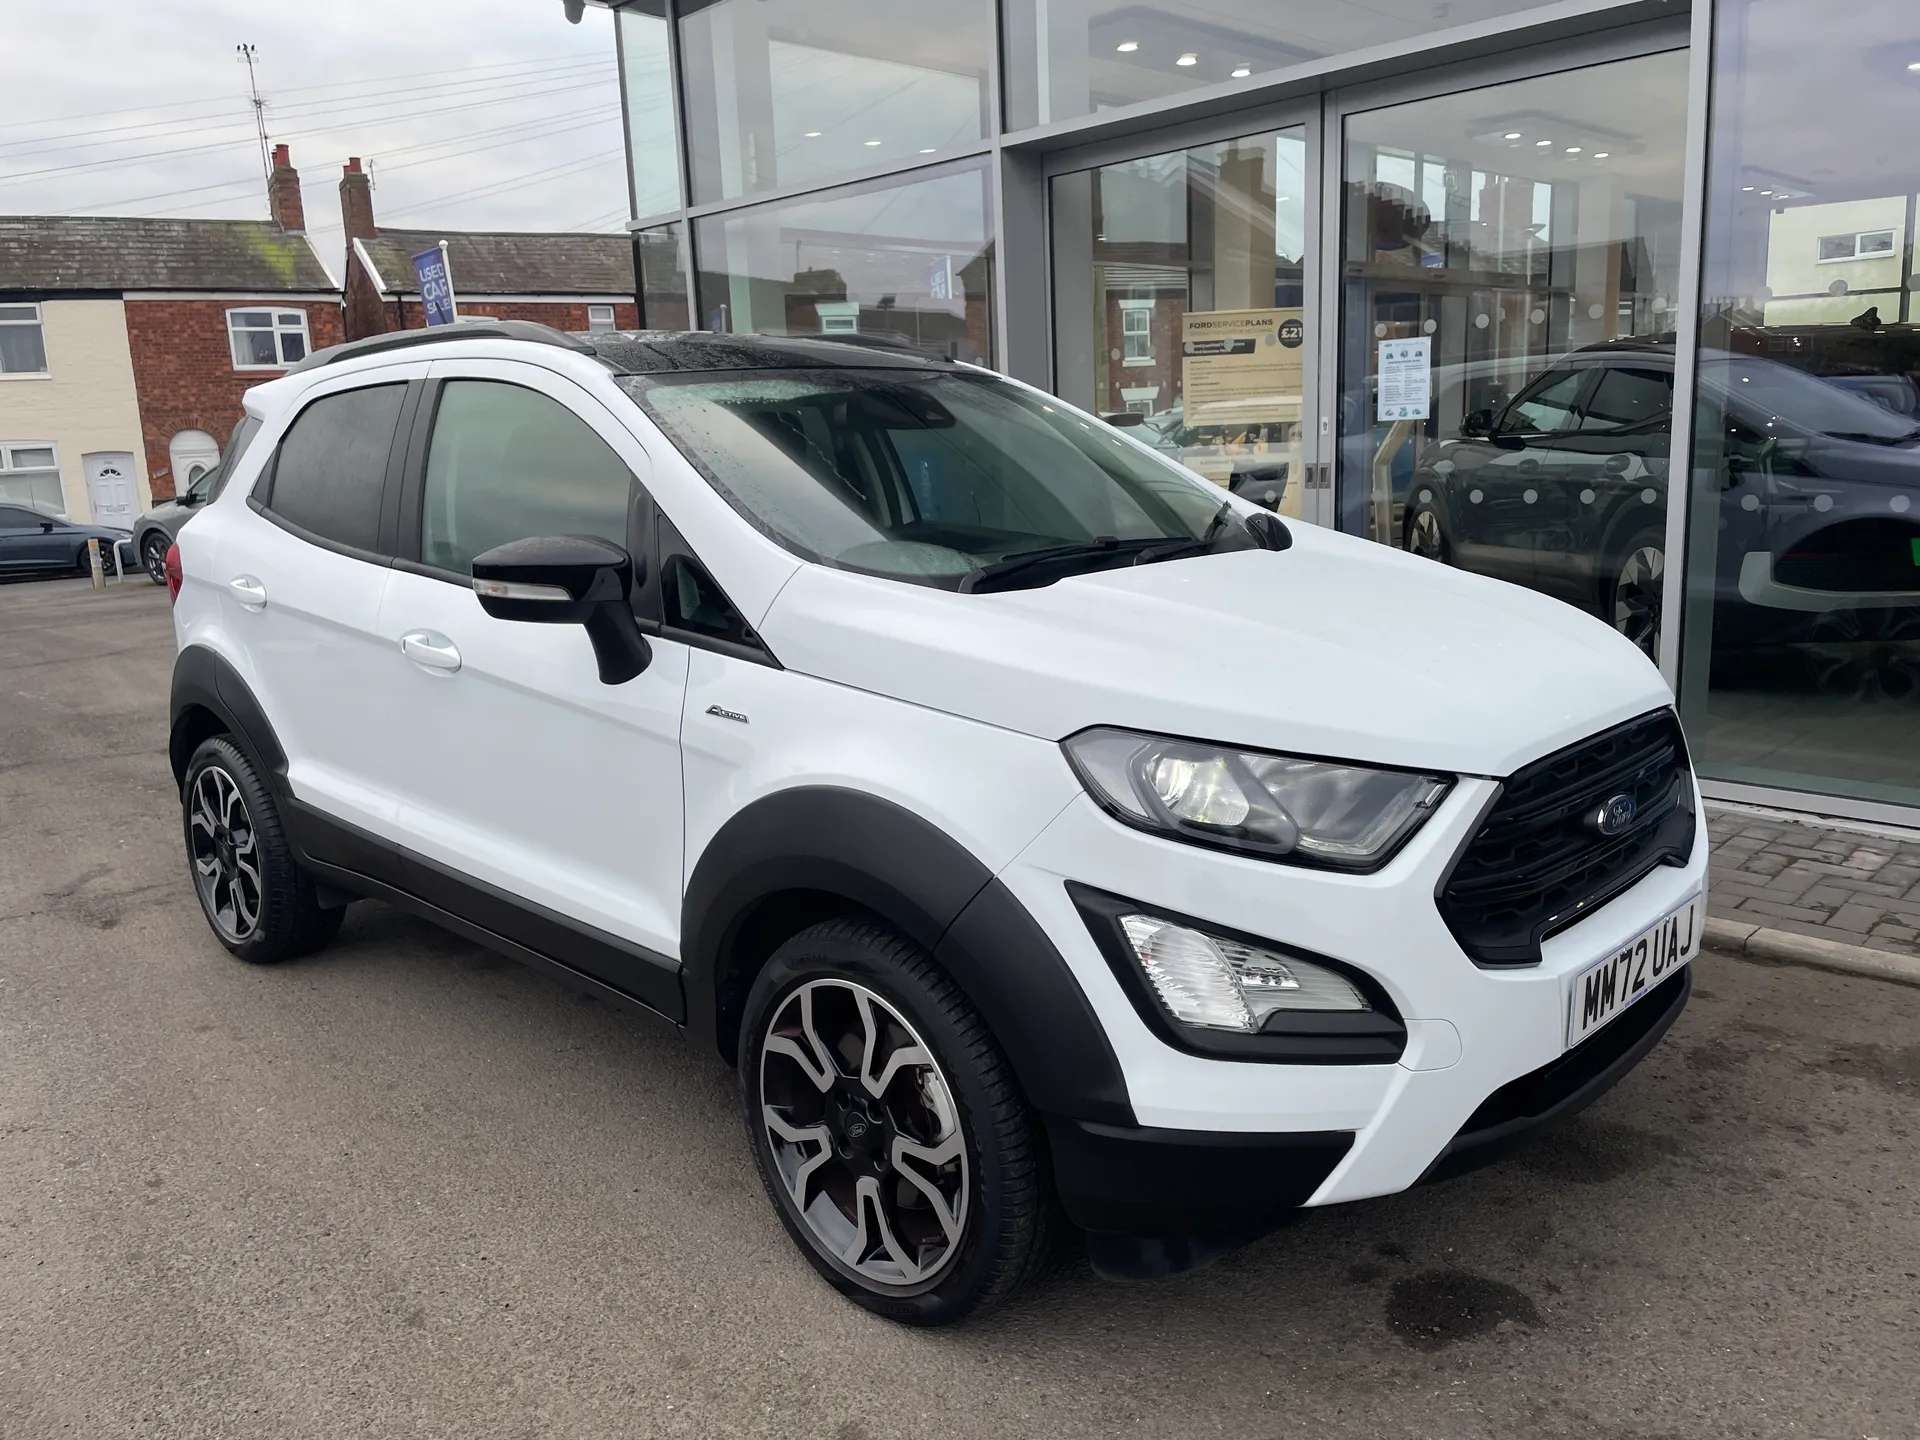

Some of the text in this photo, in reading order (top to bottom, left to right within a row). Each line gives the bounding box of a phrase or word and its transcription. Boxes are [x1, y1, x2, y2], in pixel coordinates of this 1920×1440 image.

[419, 264, 444, 282] USED
[1582, 904, 1695, 1030] MM72 UAJ
